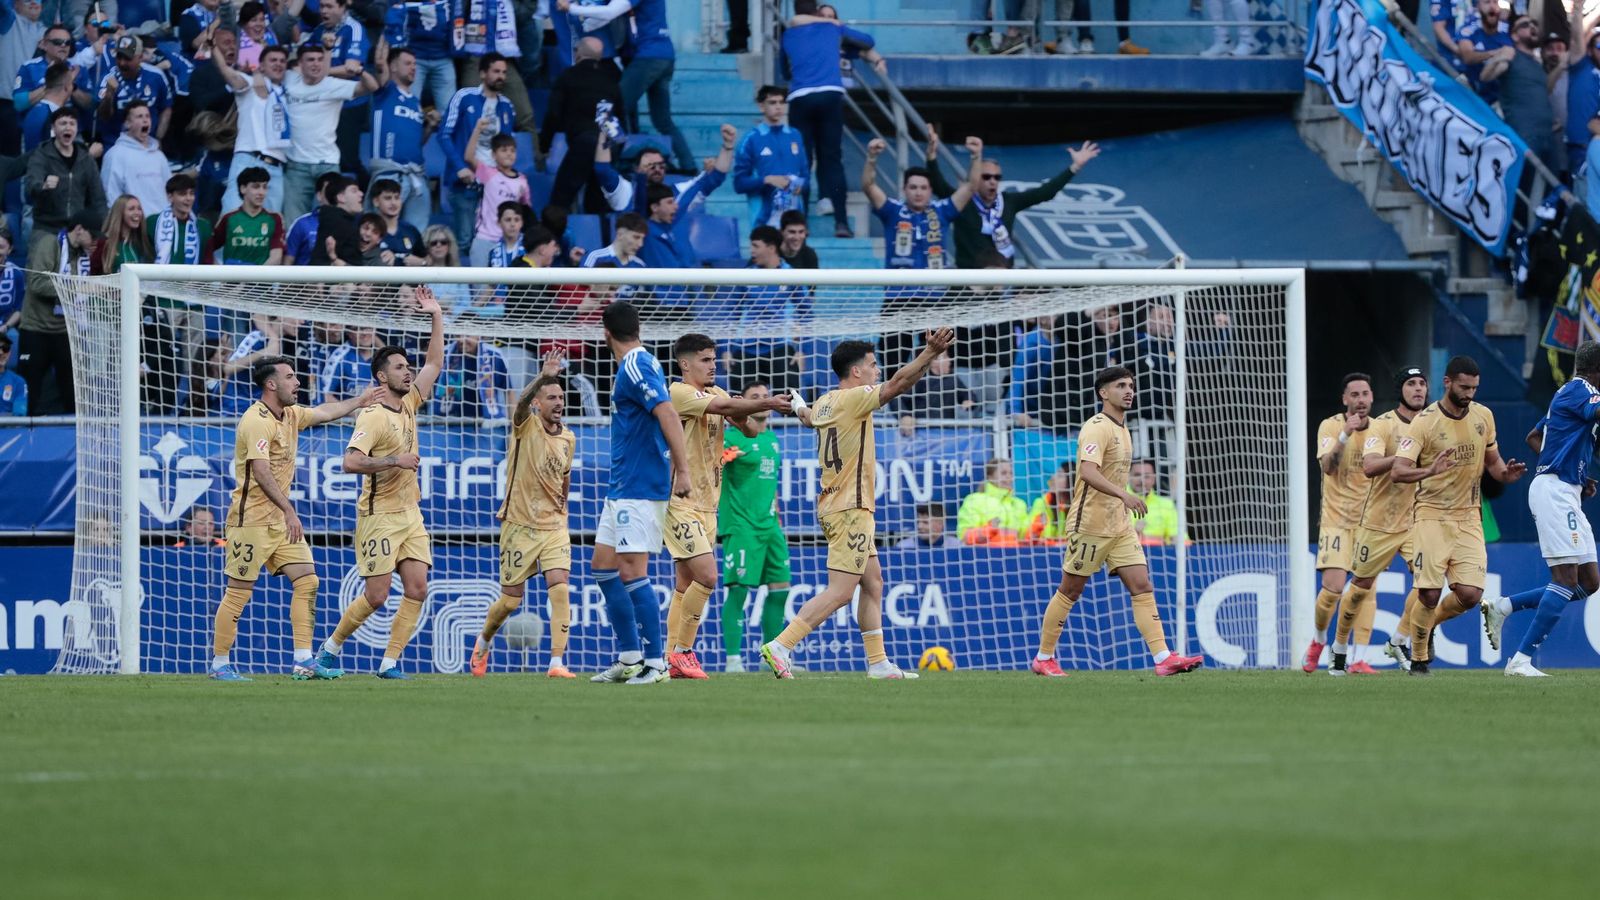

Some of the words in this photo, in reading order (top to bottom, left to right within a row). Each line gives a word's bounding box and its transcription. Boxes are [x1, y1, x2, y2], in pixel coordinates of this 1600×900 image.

[681, 520, 704, 539] 27
[1567, 511, 1578, 531] 6
[243, 544, 254, 562] 3
[368, 538, 391, 557] 20
[1081, 543, 1097, 562] 11
[1325, 536, 1341, 552] 14
[506, 550, 523, 567] 12
[739, 549, 746, 567] 1
[1414, 552, 1423, 571] 4
